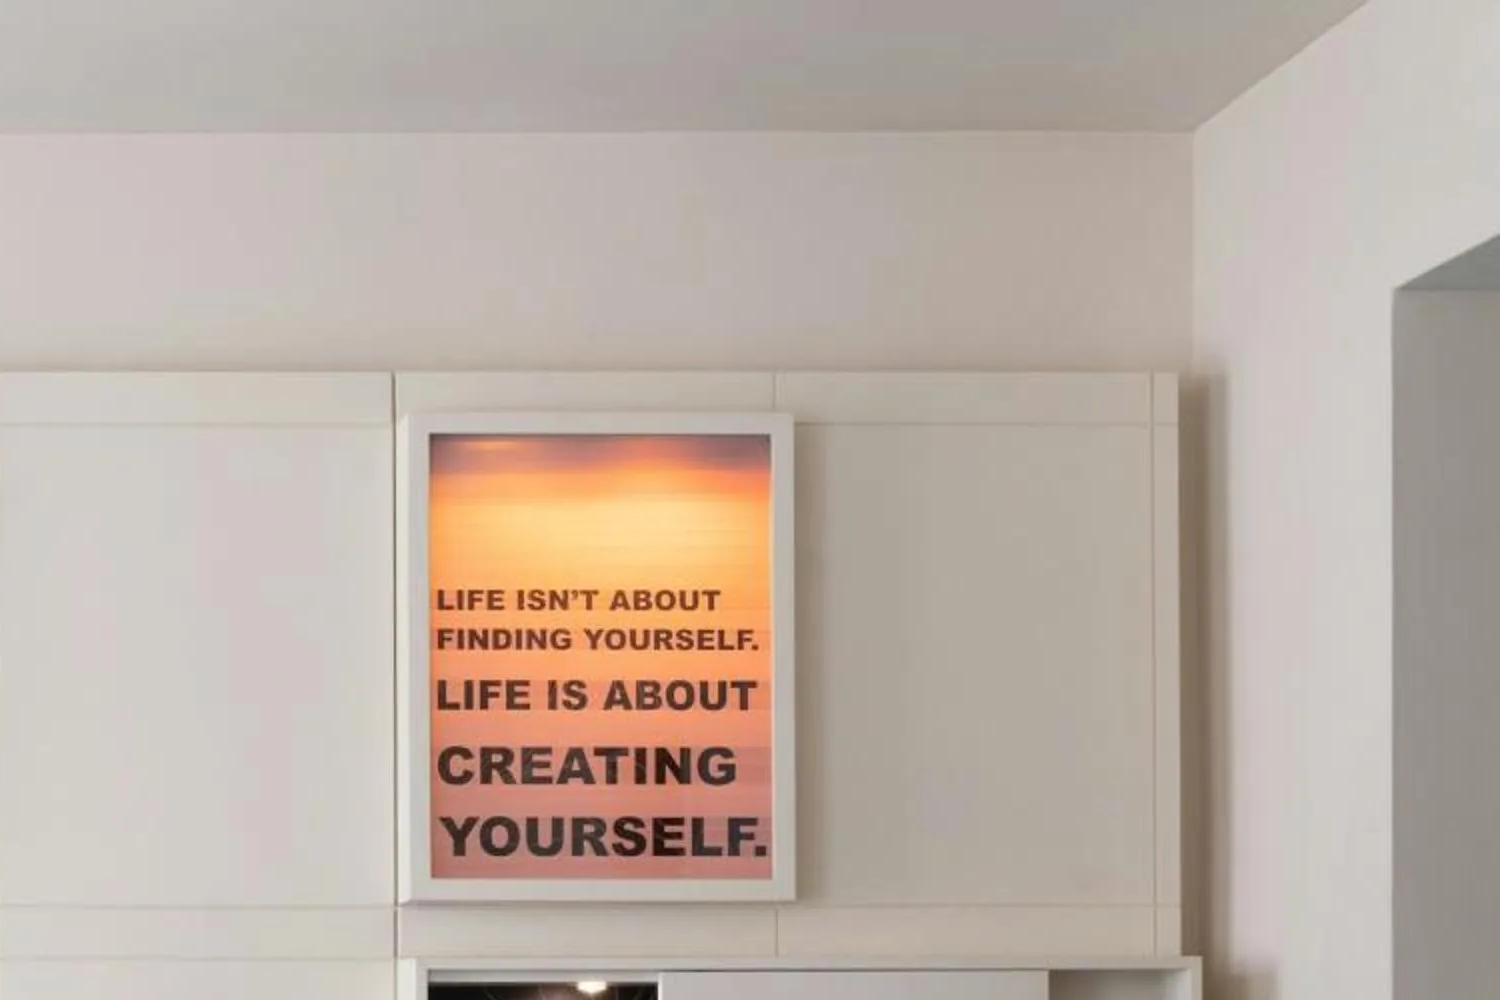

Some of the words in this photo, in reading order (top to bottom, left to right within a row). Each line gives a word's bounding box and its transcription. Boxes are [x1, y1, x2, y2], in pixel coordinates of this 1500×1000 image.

[436, 589, 505, 611] LIFE
[609, 589, 721, 611] ABOUT
[436, 628, 573, 651] FINDING
[583, 628, 760, 651] YOURSELF.
[436, 680, 531, 711] LIFE
[547, 680, 588, 711] IS
[602, 680, 758, 711] ABOUT
[436, 745, 738, 785] CREATING
[439, 816, 768, 857] YOURSELF.
